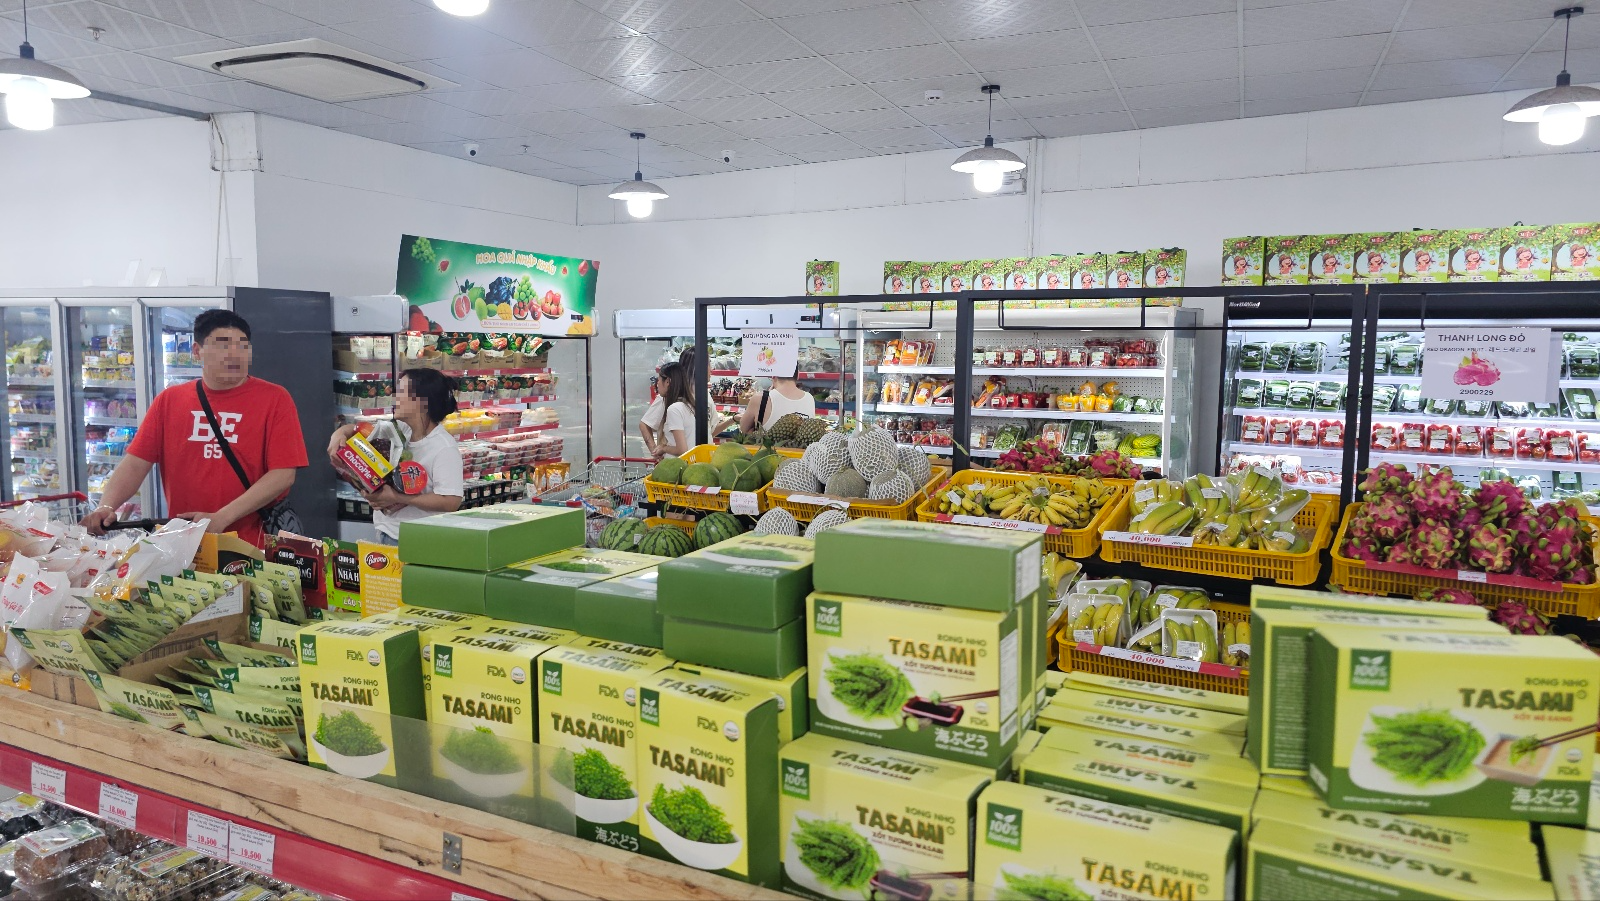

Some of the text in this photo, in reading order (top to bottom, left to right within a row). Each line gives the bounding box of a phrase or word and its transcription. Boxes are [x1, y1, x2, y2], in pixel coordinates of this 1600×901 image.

[476, 252, 496, 265] HOA
[497, 250, 516, 265] QUẢ
[515, 253, 537, 268] NHẬP
[1438, 333, 1526, 342] THANH LONG ĐỎ
[203, 443, 223, 459] 65
[816, 613, 840, 625] 100%
[484, 626, 552, 642] TASAMI
[937, 633, 987, 647] RONG NHO
[346, 650, 364, 662] FDA
[586, 640, 659, 658] TASAMI
[888, 636, 976, 667] TASAMI
[487, 664, 507, 678] FDA
[1354, 664, 1387, 678] 100%
[343, 676, 379, 687] RONG NHO
[599, 684, 619, 698] FDA
[657, 677, 736, 703] TASAMI
[1525, 677, 1558, 687] RONG
[123, 690, 175, 711] TASAMI
[310, 681, 373, 707] TASAMI
[481, 691, 521, 705] RONG NHO
[1459, 687, 1575, 712] TASAMI
[235, 710, 294, 727] TASAMI
[442, 693, 513, 725] TASAMI
[1107, 698, 1200, 719] TASAMI
[551, 711, 626, 748] TASAMI
[592, 712, 634, 729] RONG NHO
[697, 716, 719, 733] FDA
[1097, 715, 1195, 738] TASAMI
[224, 725, 283, 749] TASAMI
[934, 727, 988, 750] 海ぶどう
[690, 746, 734, 766] RONG NHO
[1093, 739, 1197, 763] TASAMI
[649, 744, 726, 787] TASAMI
[831, 749, 922, 776] TASAMI
[784, 774, 807, 788] 100%
[1088, 761, 1198, 790] TASAMI
[1511, 787, 1580, 806] 海ぶどう
[905, 806, 956, 824] RONG NHO
[1044, 795, 1154, 825] TASAMI
[856, 804, 945, 845] TASAMI
[990, 819, 1019, 838] 100%
[1317, 807, 1453, 845] TASAMI
[595, 826, 639, 852] 海ぶどう
[1145, 860, 1209, 882] RONG NHO
[1332, 842, 1479, 884] TASAMI
[1082, 856, 1195, 901] TASAMI
